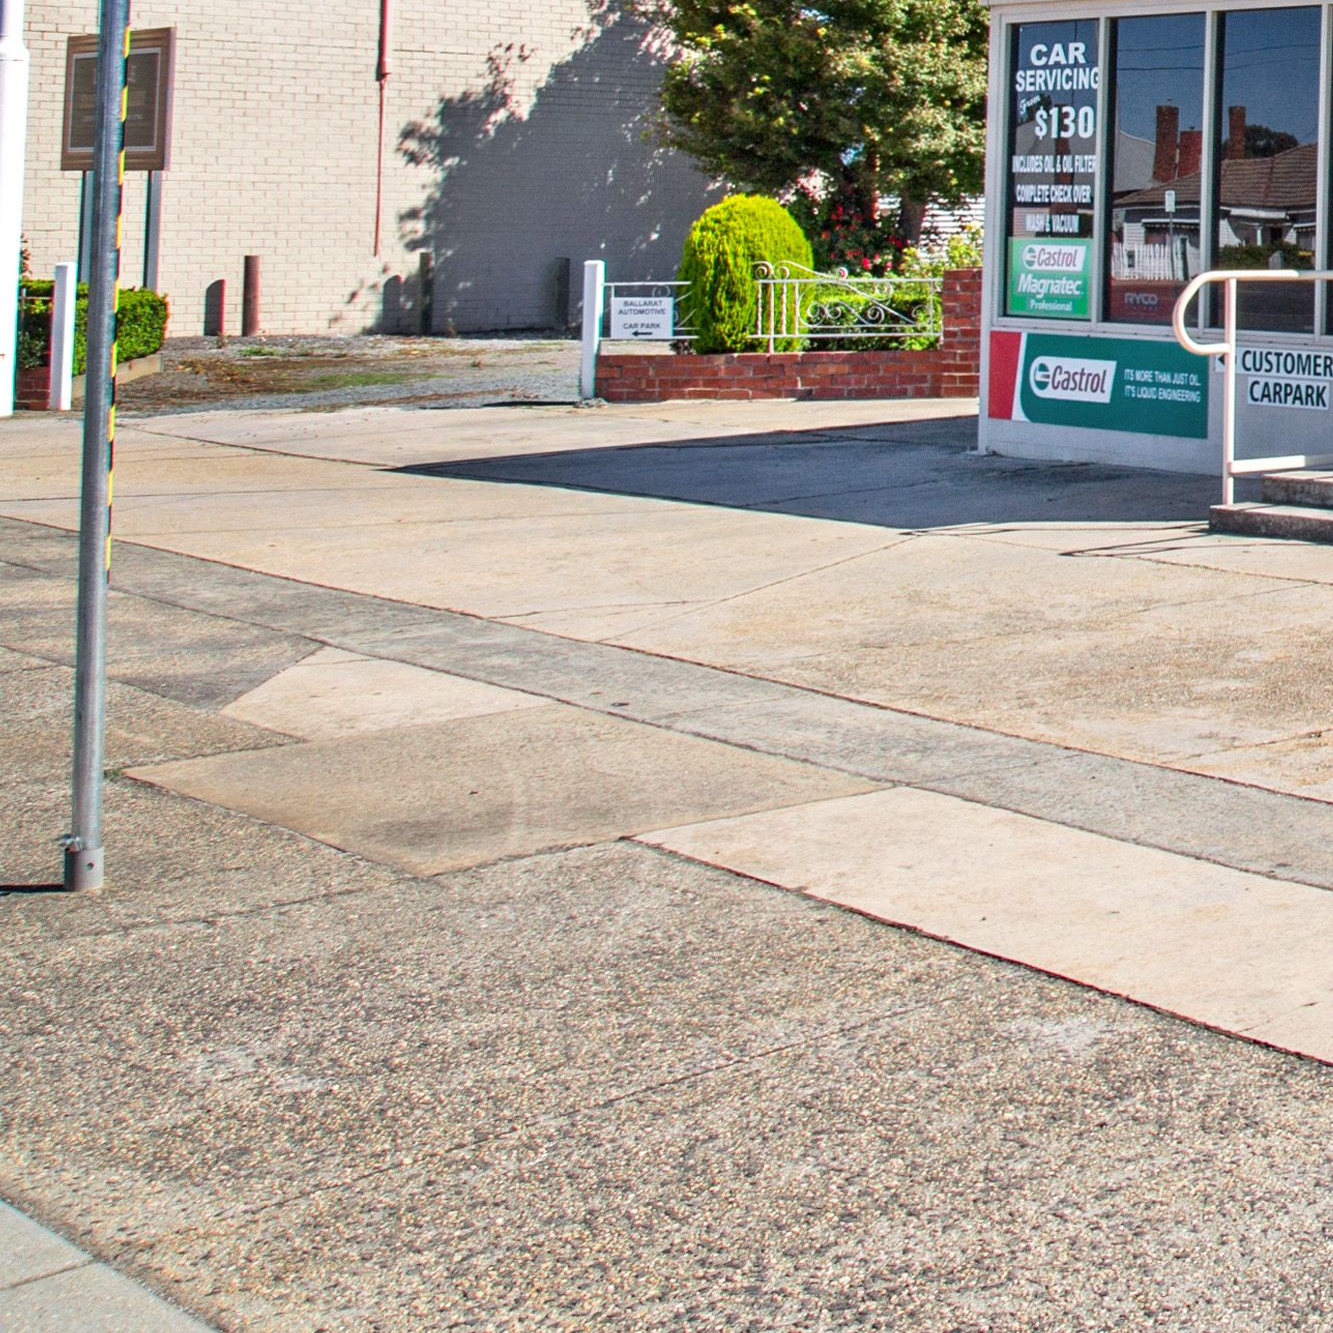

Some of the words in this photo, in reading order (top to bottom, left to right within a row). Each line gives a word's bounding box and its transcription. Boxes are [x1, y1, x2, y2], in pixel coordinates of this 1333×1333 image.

[1031, 42, 1086, 66] CAR
[1016, 67, 1099, 92] SERVICING
[1035, 106, 1094, 140] $130
[1012, 155, 1043, 173] INCLUDES
[1044, 155, 1055, 173] OIL
[1056, 155, 1061, 173] &
[1062, 155, 1073, 173] OIL
[1016, 184, 1050, 203] COMPLETE
[1050, 184, 1073, 203] CHECK
[1073, 184, 1091, 203] OVER
[1051, 214, 1079, 233] VACUUM
[1037, 248, 1078, 267] Castrol
[1017, 273, 1082, 298] Magnatec
[1030, 299, 1072, 311] Professional
[1124, 292, 1159, 305] RYCO
[1241, 350, 1333, 378] CUSTOMER
[1051, 365, 1107, 394] Castrol
[1135, 370, 1153, 382] MORE
[1154, 371, 1171, 383] THAN
[1172, 372, 1188, 385] JUST
[1136, 386, 1156, 399] LIQUID
[1158, 388, 1201, 403] ENGINEERING
[1249, 380, 1327, 407] CARPARK
